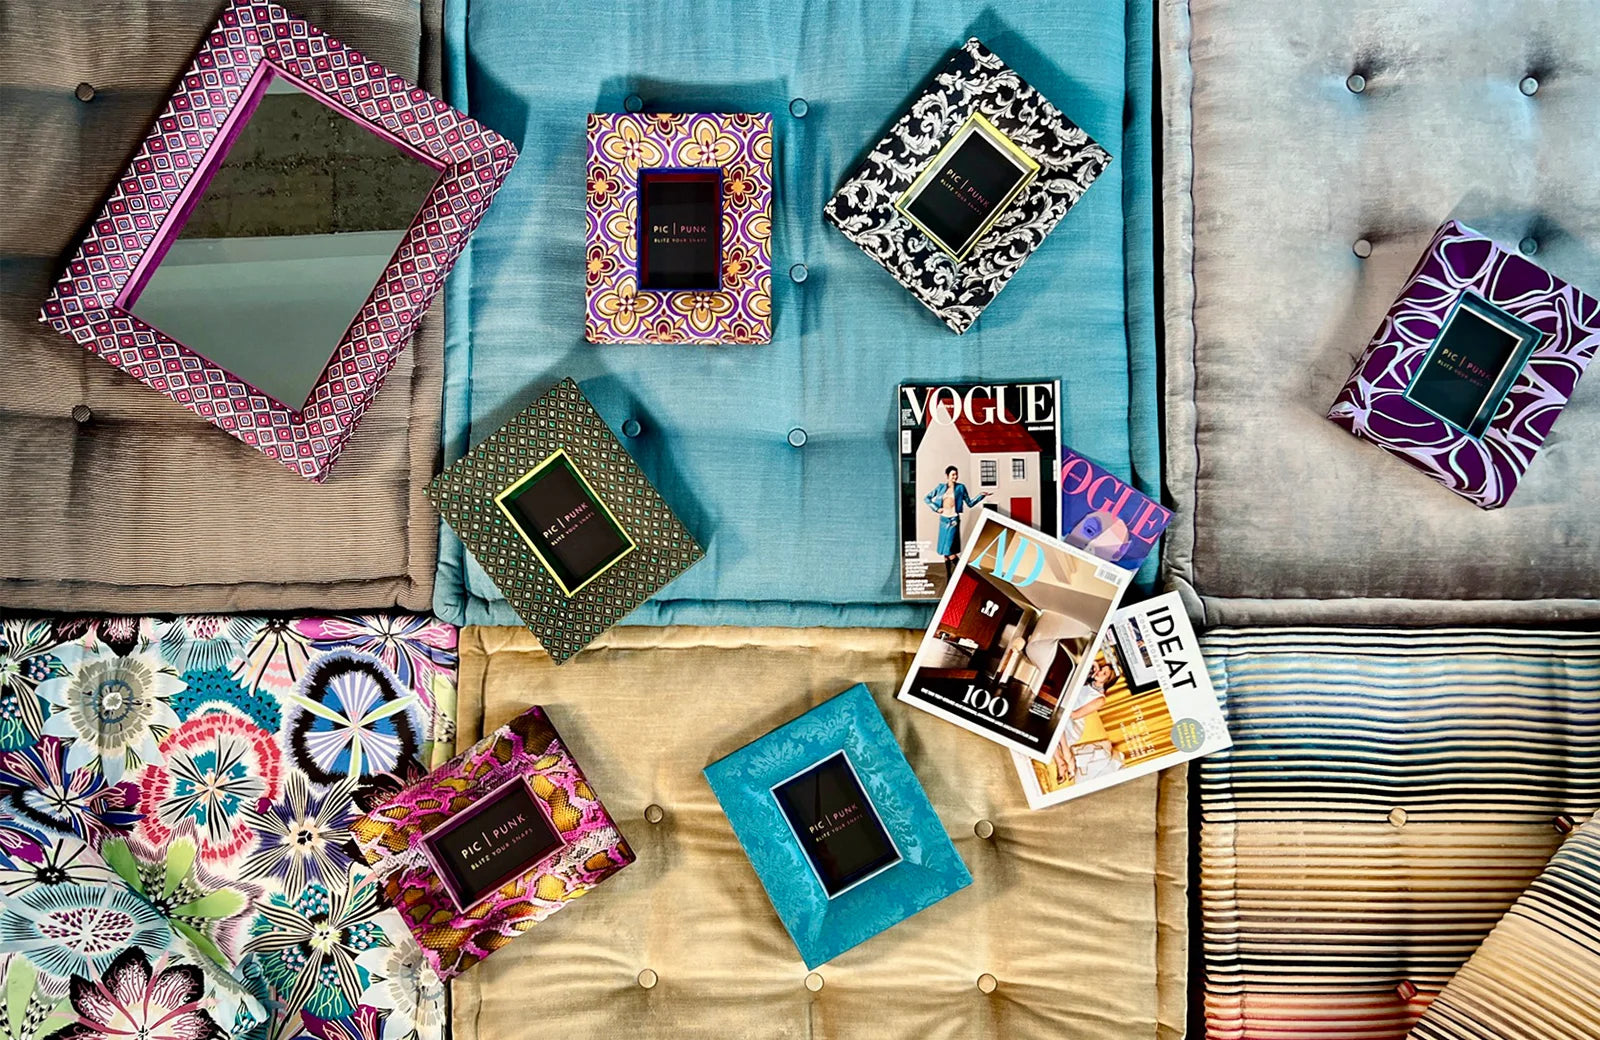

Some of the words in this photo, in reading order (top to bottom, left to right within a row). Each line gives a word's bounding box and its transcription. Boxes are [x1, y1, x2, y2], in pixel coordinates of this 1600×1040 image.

[946, 168, 961, 183] PIC
[967, 186, 990, 208] PUNK
[653, 225, 669, 234] PIC
[680, 225, 706, 233] PUNK
[1442, 348, 1458, 362] PIC
[901, 383, 1054, 426] VOGUE
[542, 524, 559, 539] PIC
[564, 501, 589, 522] PUNK
[967, 528, 1046, 588] AD
[1146, 605, 1198, 689] IDEAT
[962, 684, 1009, 718] 100
[461, 841, 482, 860] PIC
[492, 813, 526, 839] PUNK
[809, 820, 825, 834] PIC
[833, 802, 858, 820] PUNK
[470, 854, 490, 870] BLITZ
[492, 842, 510, 856] YOUR
[512, 827, 533, 843] SNAPS
